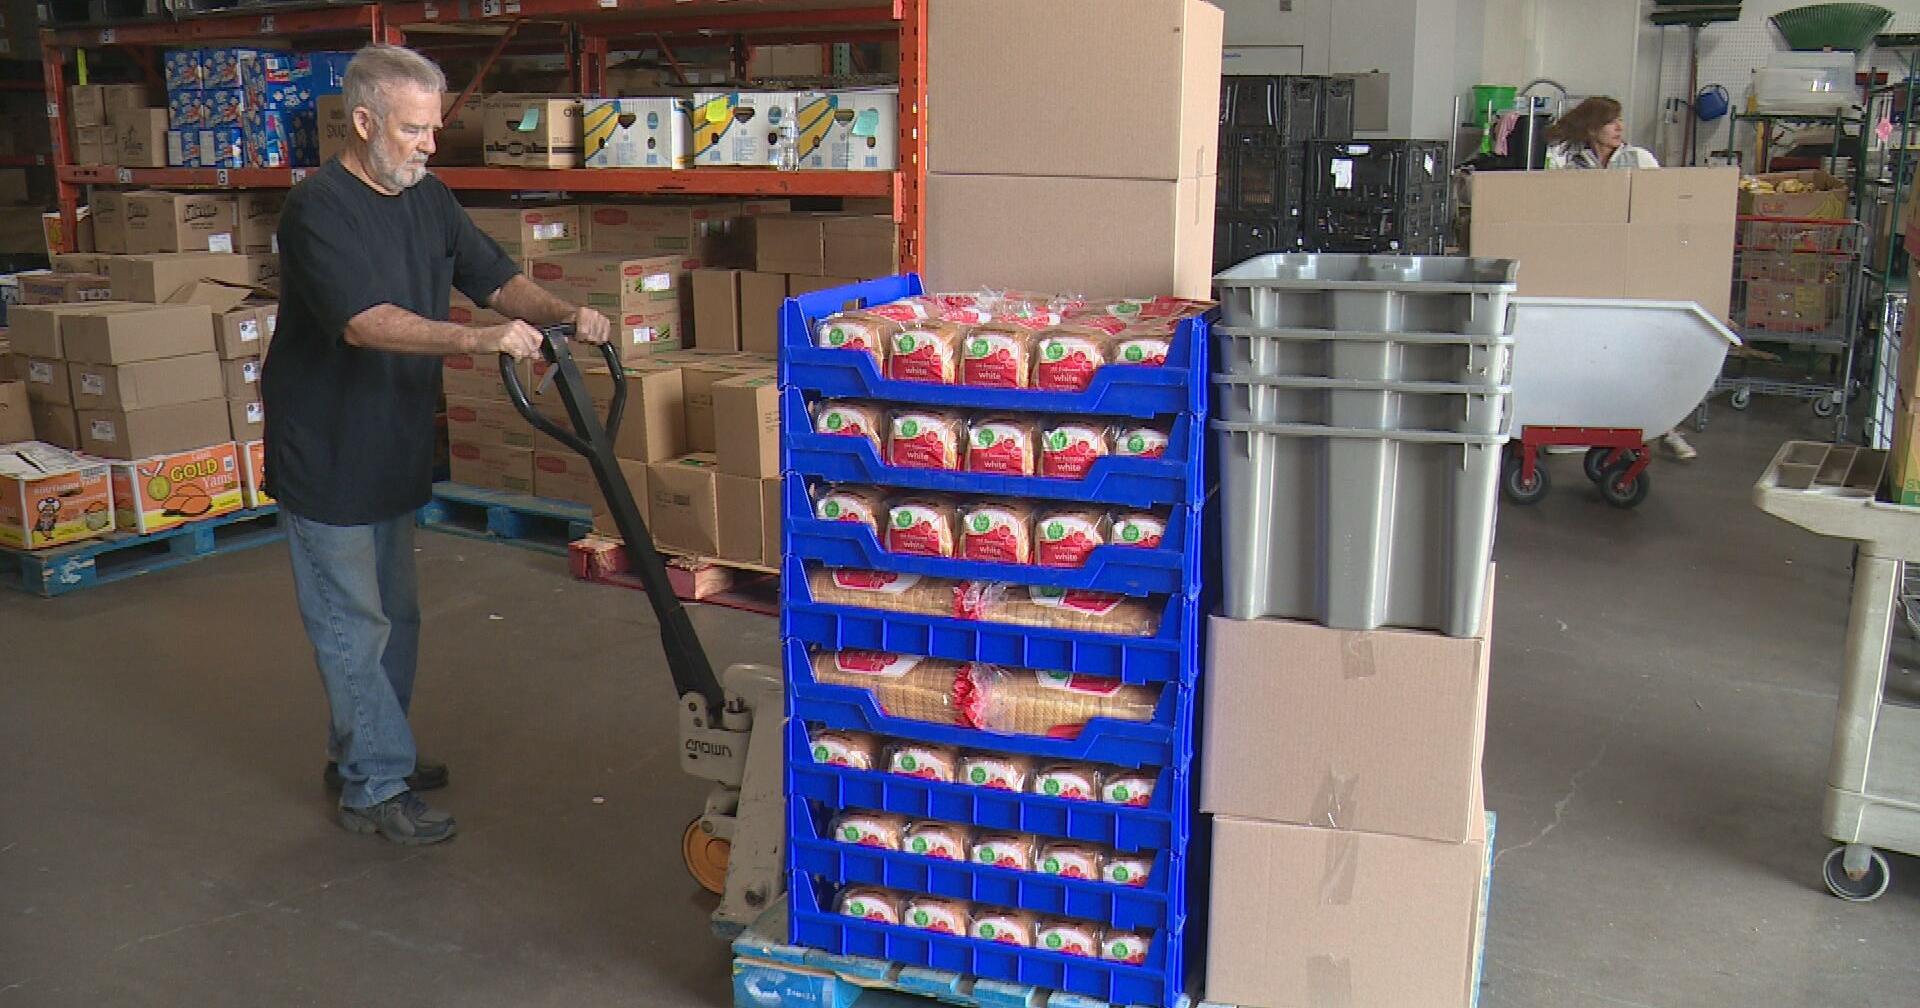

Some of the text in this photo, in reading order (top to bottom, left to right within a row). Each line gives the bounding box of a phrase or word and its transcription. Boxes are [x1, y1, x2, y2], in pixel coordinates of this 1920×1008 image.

[905, 367, 927, 375] white
[978, 372, 1001, 380] white
[1053, 374, 1078, 383] white
[906, 452, 929, 460] white
[984, 461, 1007, 469] white
[1057, 464, 1081, 472] white
[170, 458, 218, 482] GOLD
[201, 473, 233, 489] Yams
[1054, 553, 1079, 561] white
